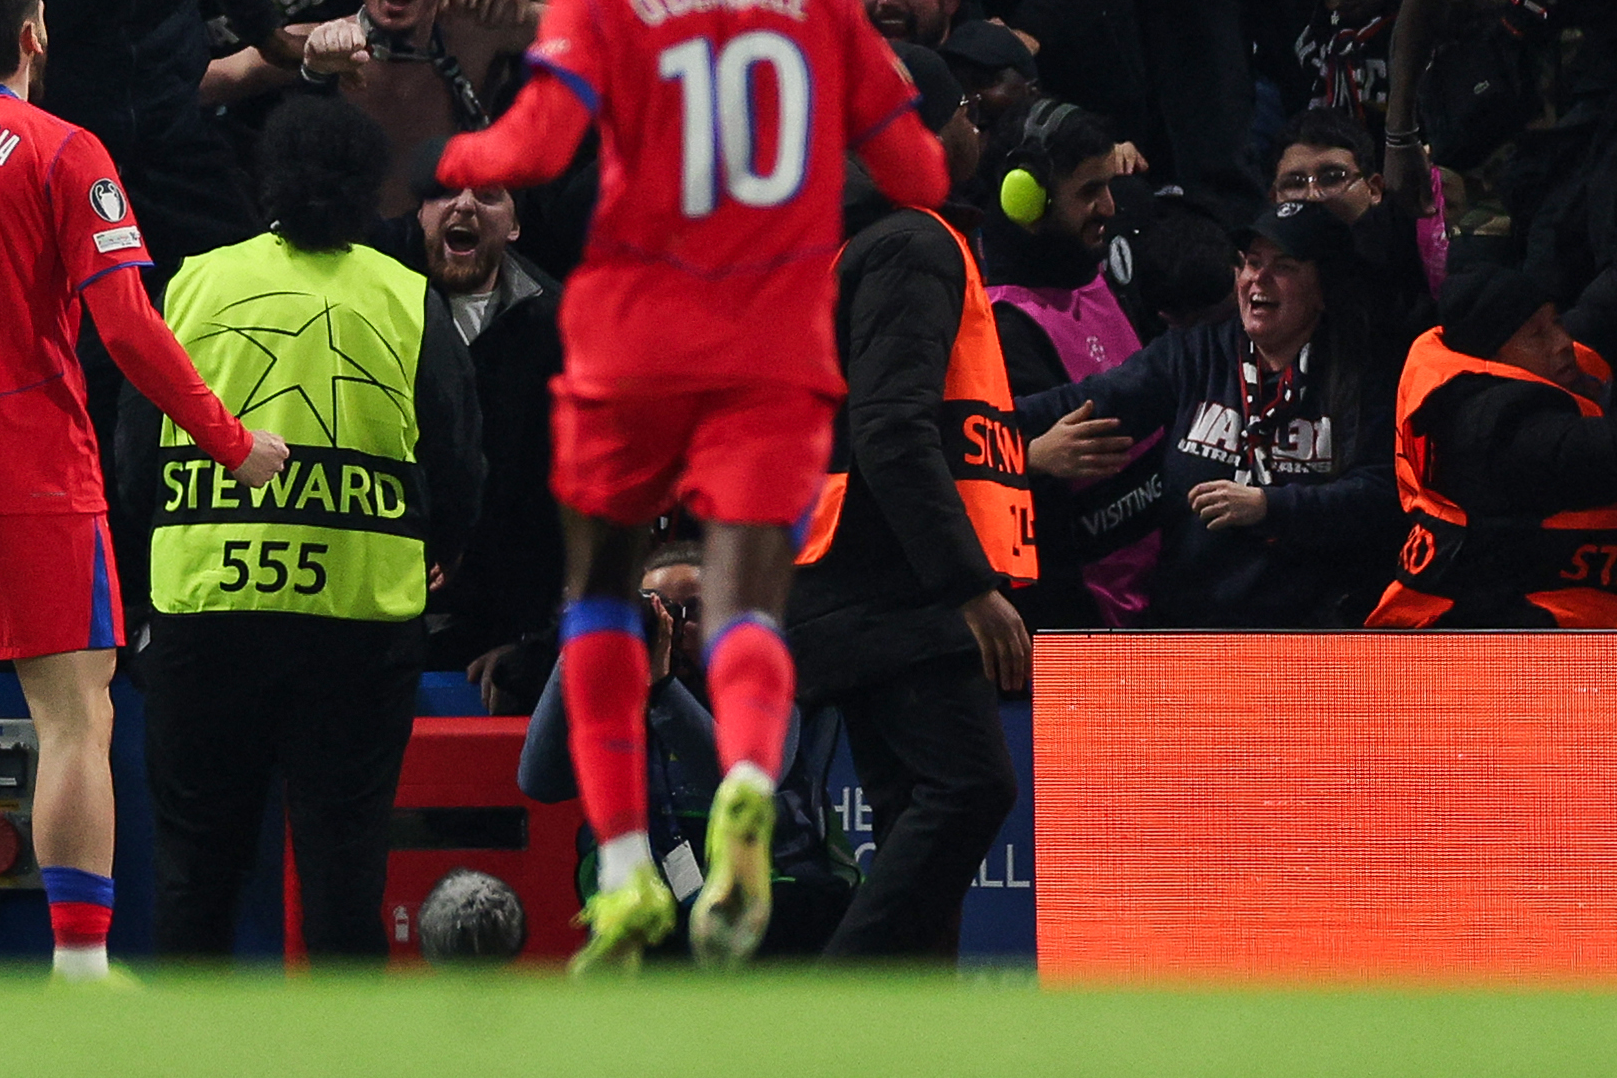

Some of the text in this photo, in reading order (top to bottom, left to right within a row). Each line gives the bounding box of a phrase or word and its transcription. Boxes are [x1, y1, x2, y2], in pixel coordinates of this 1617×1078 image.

[657, 29, 816, 219] 10
[162, 458, 407, 520] STEWARD
[1081, 472, 1163, 535] VISITING
[219, 540, 328, 594] 555
